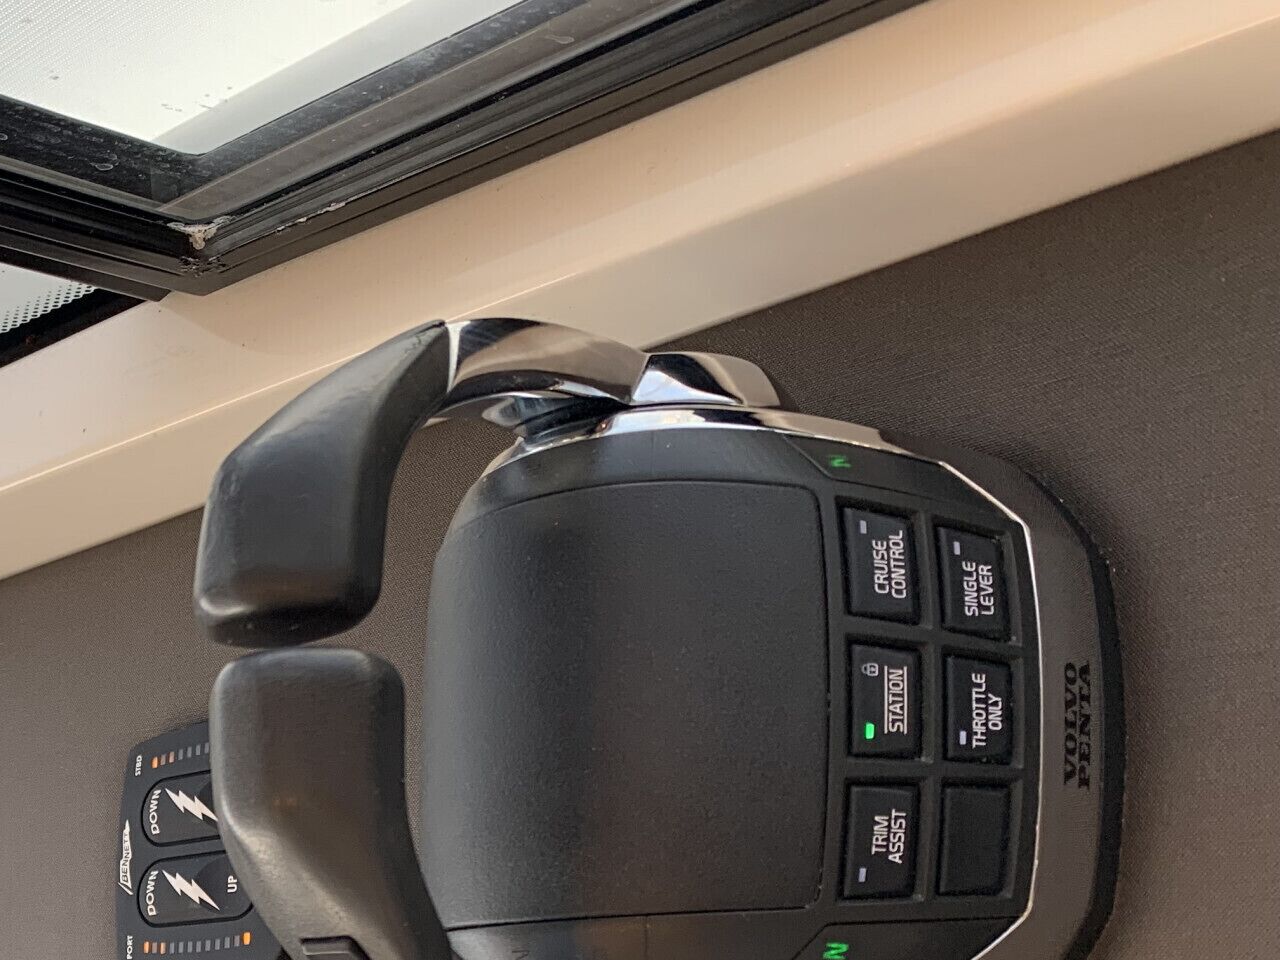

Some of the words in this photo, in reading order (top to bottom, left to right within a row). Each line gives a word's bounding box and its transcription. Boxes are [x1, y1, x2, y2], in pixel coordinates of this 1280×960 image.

[828, 454, 851, 468] N
[872, 540, 890, 594] CRUISE
[887, 530, 907, 599] CONTROL
[962, 561, 981, 616] SINGLE
[976, 565, 995, 616] LEVER
[888, 669, 904, 733] STATION
[970, 672, 988, 748] THROTTLE
[987, 692, 1004, 731] ONLY
[1062, 662, 1078, 785] VOLVO
[1078, 663, 1092, 790] PENTA
[134, 754, 144, 776] STBD
[148, 789, 161, 835] DOWN
[870, 814, 890, 855] TRIM
[888, 808, 907, 864] ASSIST
[120, 832, 131, 884] BENNETT
[146, 870, 158, 916] DOWN
[226, 875, 238, 894] UP
[822, 942, 850, 960] N
